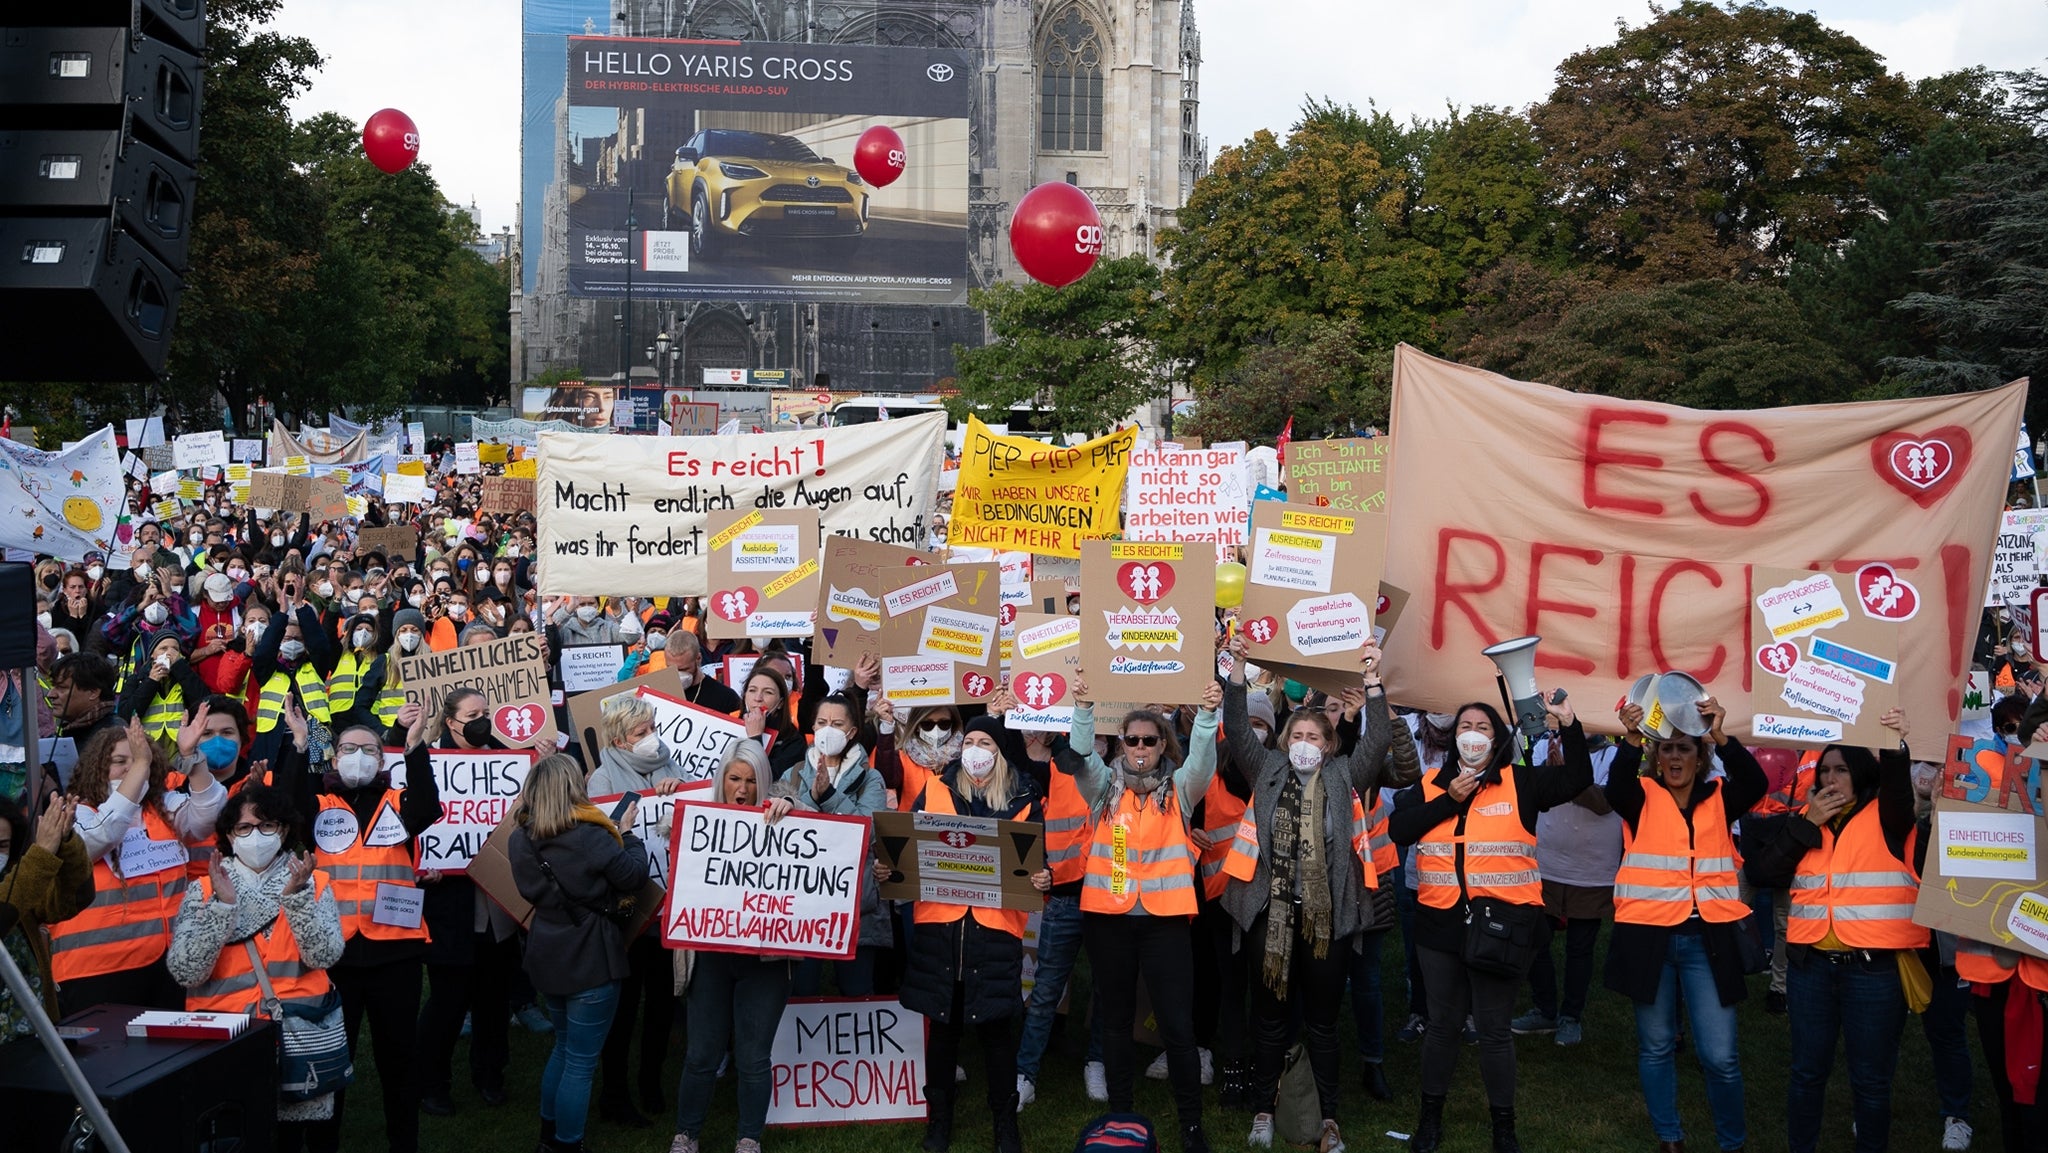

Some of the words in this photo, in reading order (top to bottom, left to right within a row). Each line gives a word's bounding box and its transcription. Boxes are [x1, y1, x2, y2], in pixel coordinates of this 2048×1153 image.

[585, 51, 671, 76] HELLO
[680, 54, 753, 78] YARIS
[762, 58, 853, 81] CROSS
[585, 80, 606, 90] DER
[608, 81, 720, 94] HYBRID-ELEKTRISCHE
[722, 84, 789, 95] ALLRAD-SUV
[585, 235, 612, 243] Exklusiv
[869, 276, 952, 285] TOYOTA.AT/YARIS-CROSS
[679, 407, 706, 424] MIR
[1128, 449, 1155, 466] Ich
[1158, 448, 1202, 466] kann
[1207, 451, 1237, 469] gar
[1296, 446, 1321, 460] Ich
[1339, 442, 1366, 457] bin
[668, 451, 700, 476] Es
[1291, 459, 1381, 478] BASTELTANTE
[1582, 406, 1776, 526] ES
[502, 479, 533, 493] GEHALT
[1141, 468, 1188, 485] nicht
[1199, 472, 1221, 486] so
[1299, 479, 1319, 494] ich
[1330, 476, 1352, 492] bin
[556, 481, 630, 511] Macht
[654, 485, 734, 513] endlich
[755, 485, 786, 510] die
[794, 479, 851, 511] Augen
[864, 473, 913, 509] auf,
[961, 485, 982, 501] WIR
[992, 486, 1036, 501] HABEN
[1045, 485, 1090, 503] UNSERE
[1139, 487, 1216, 505] schlecht
[983, 504, 1093, 529] BEDINGUNGEN
[1130, 509, 1209, 526] arbeiten
[1215, 506, 1248, 523] wie
[1294, 514, 1306, 525] ES
[1308, 516, 1343, 530] REICHT
[718, 532, 729, 543] ES
[728, 516, 754, 536] REICHT
[963, 526, 1007, 543] NICHT
[1013, 527, 1061, 550] MEHR
[1172, 528, 1241, 545] bezahlt
[555, 540, 588, 555] was
[596, 531, 618, 557] ihr
[628, 524, 703, 563] fordert
[742, 544, 778, 554] Ausbildung
[780, 544, 789, 553] für
[1268, 533, 1322, 549] AUSREICHEND
[1123, 546, 1135, 556] ES
[1138, 546, 1172, 557] REICHT
[1264, 548, 1321, 565] Zeitressourcen
[2009, 552, 2033, 562] MEHR
[1995, 563, 2014, 573] ALS
[772, 581, 784, 592] ES
[783, 565, 809, 585] REICHT
[1263, 574, 1286, 583] PLANUNG
[1290, 578, 1317, 587] REFLEXION
[899, 593, 912, 606] ES
[911, 582, 942, 601] REICHT
[1762, 579, 1831, 608] GRUPPENGRÖSSE
[1308, 600, 1353, 616] gesetzliche
[760, 620, 811, 629] Kinderfreunde
[930, 615, 978, 631] VERBESSERUNG
[979, 625, 990, 633] des
[1109, 615, 1177, 625] HERABSETZUNG
[1295, 617, 1345, 631] Verankerung
[1345, 615, 1360, 625] von
[1431, 527, 1970, 721] REIC!
[932, 628, 977, 643] ERWACHSENEN
[1021, 620, 1078, 643] EINHEITLICHES
[1108, 632, 1119, 641] der
[1121, 631, 1178, 641] KINDERANZAHL
[1297, 629, 1362, 648] Reflexionszeiten!
[926, 639, 941, 648] KIND
[402, 636, 540, 682] EINHEITLICHES
[583, 651, 611, 659] REICHT!
[1825, 646, 1839, 658] ES
[1841, 650, 1879, 672] REICHT
[1123, 661, 1184, 673] Kinderfreunde
[1810, 664, 1857, 688] gesetzliche
[406, 667, 548, 718] BUNRAHMEN-
[1790, 671, 1840, 702] Verankerung
[1843, 694, 1858, 706] von
[1784, 687, 1853, 722] Reflexionszeiten!
[1021, 713, 1072, 724] Kinderfreunde
[1771, 723, 1836, 738] Kinderfreunde
[697, 726, 738, 754] IST
[389, 761, 521, 796] GICHES
[323, 818, 344, 826] MEHR
[930, 819, 993, 831] Kinderfreunde
[316, 828, 356, 838] PERSONAL
[691, 815, 827, 859] BILDUNGS-
[1949, 829, 2025, 844] EINHEITLICHES
[924, 850, 994, 863] HERABSETZUNG
[1114, 836, 1124, 870] REICHT
[1946, 847, 2028, 862] Bundesrahmengesetz
[937, 861, 995, 873] KINDERANZAHL
[705, 857, 854, 898] EINRICHTUNG
[1114, 871, 1123, 883] ES
[743, 891, 795, 915] KEINE
[937, 888, 950, 897] ES
[951, 889, 986, 900] REICHT
[669, 907, 849, 950] AUFBEWAHRUNG!!
[796, 1008, 904, 1055] MEHR
[772, 1059, 927, 1108] PERSONAL
